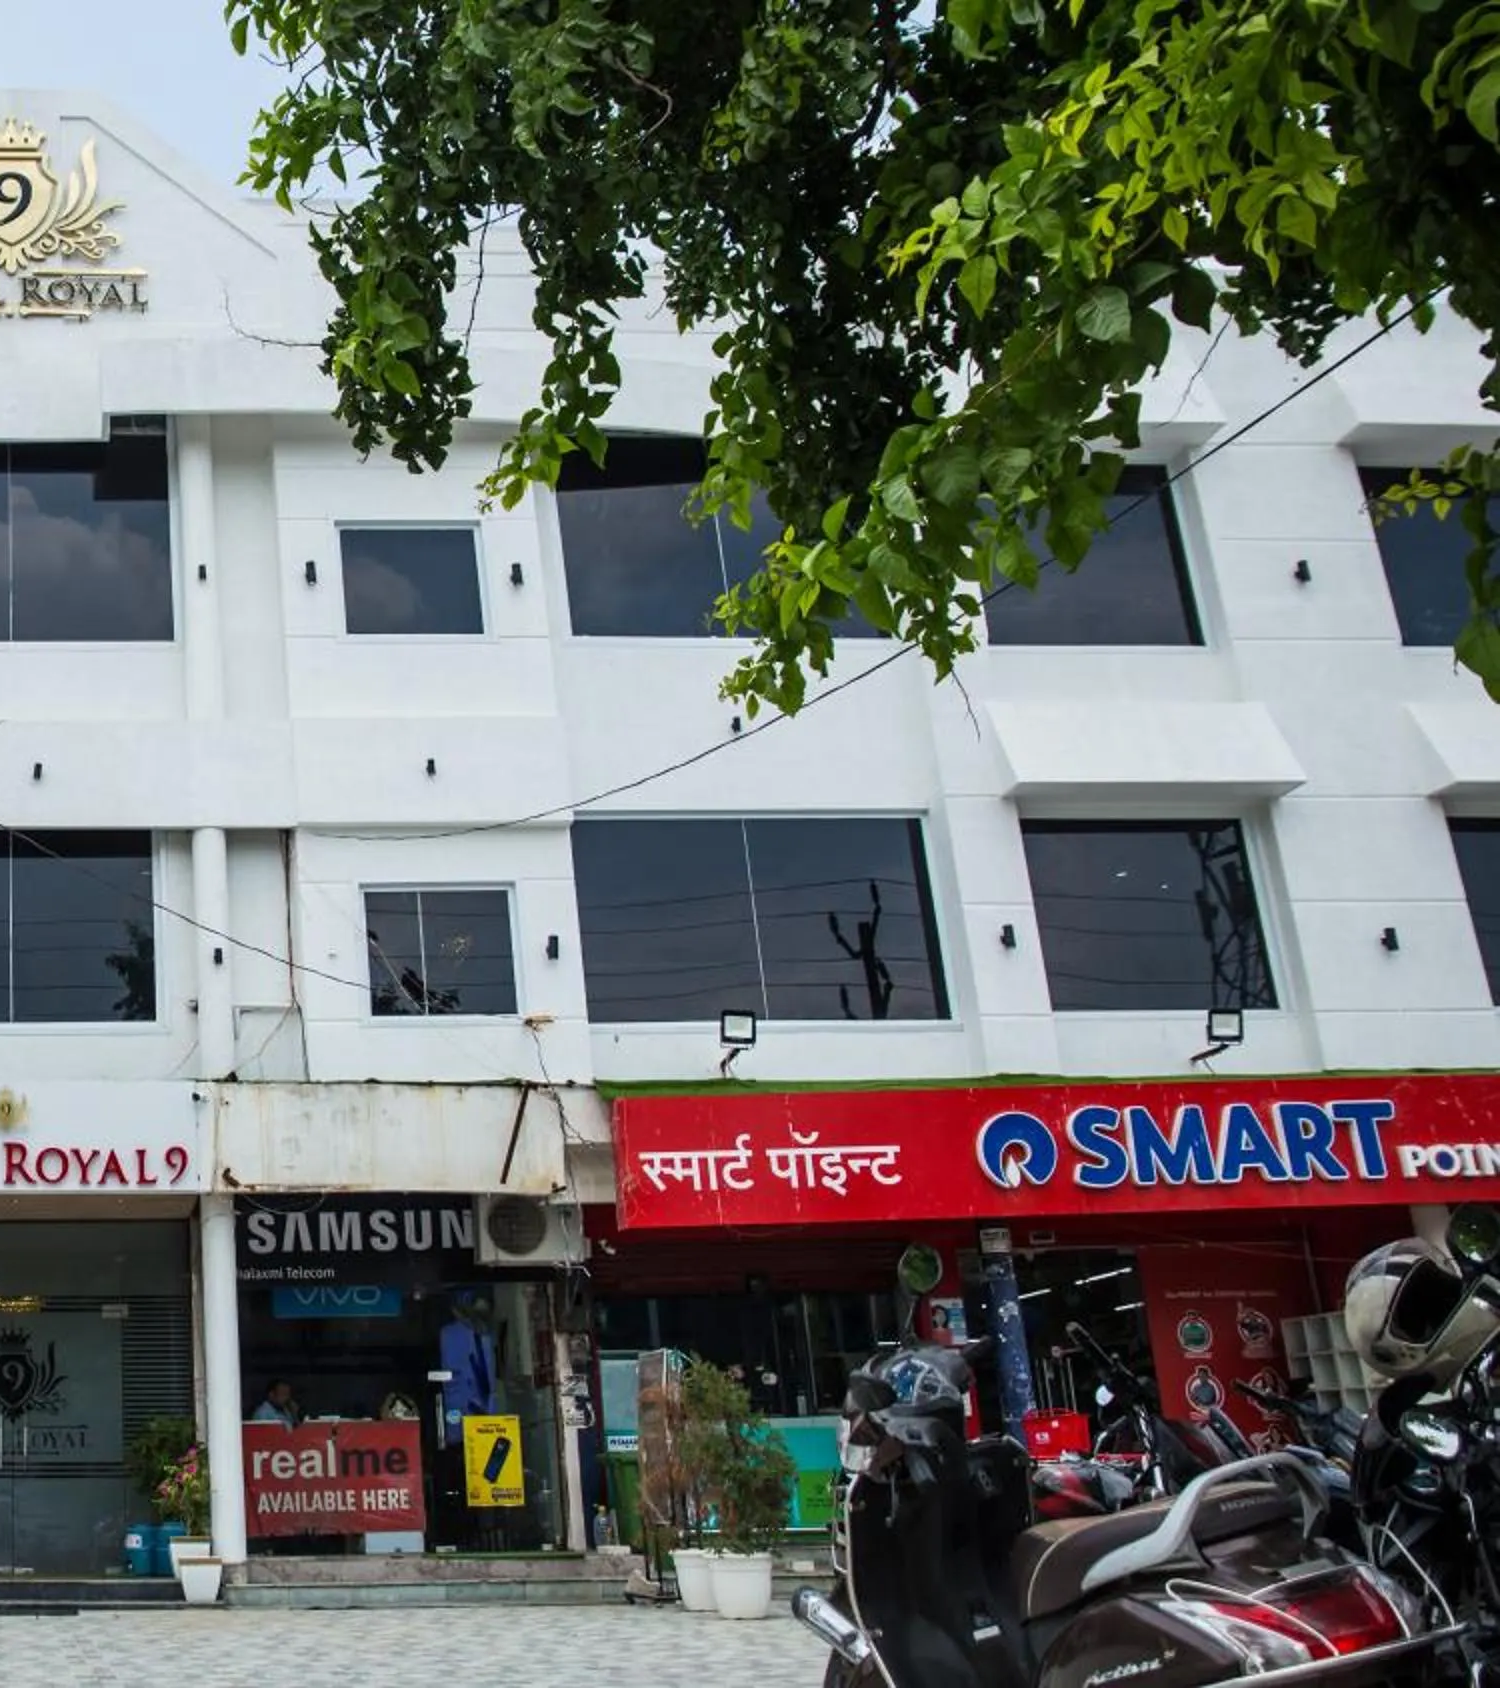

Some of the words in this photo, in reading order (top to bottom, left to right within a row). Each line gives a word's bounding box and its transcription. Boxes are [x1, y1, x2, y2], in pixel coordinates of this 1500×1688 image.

[20, 277, 149, 308] ROYAL
[1067, 1098, 1395, 1189] SMART
[638, 1132, 755, 1193] स्मार्ट
[766, 1129, 903, 1197] पॉइन्ट
[286, 1266, 336, 1280] Telecom
[252, 1439, 408, 1480] realme
[258, 1489, 356, 1514] AVAILABLE
[362, 1487, 411, 1511] HERE
